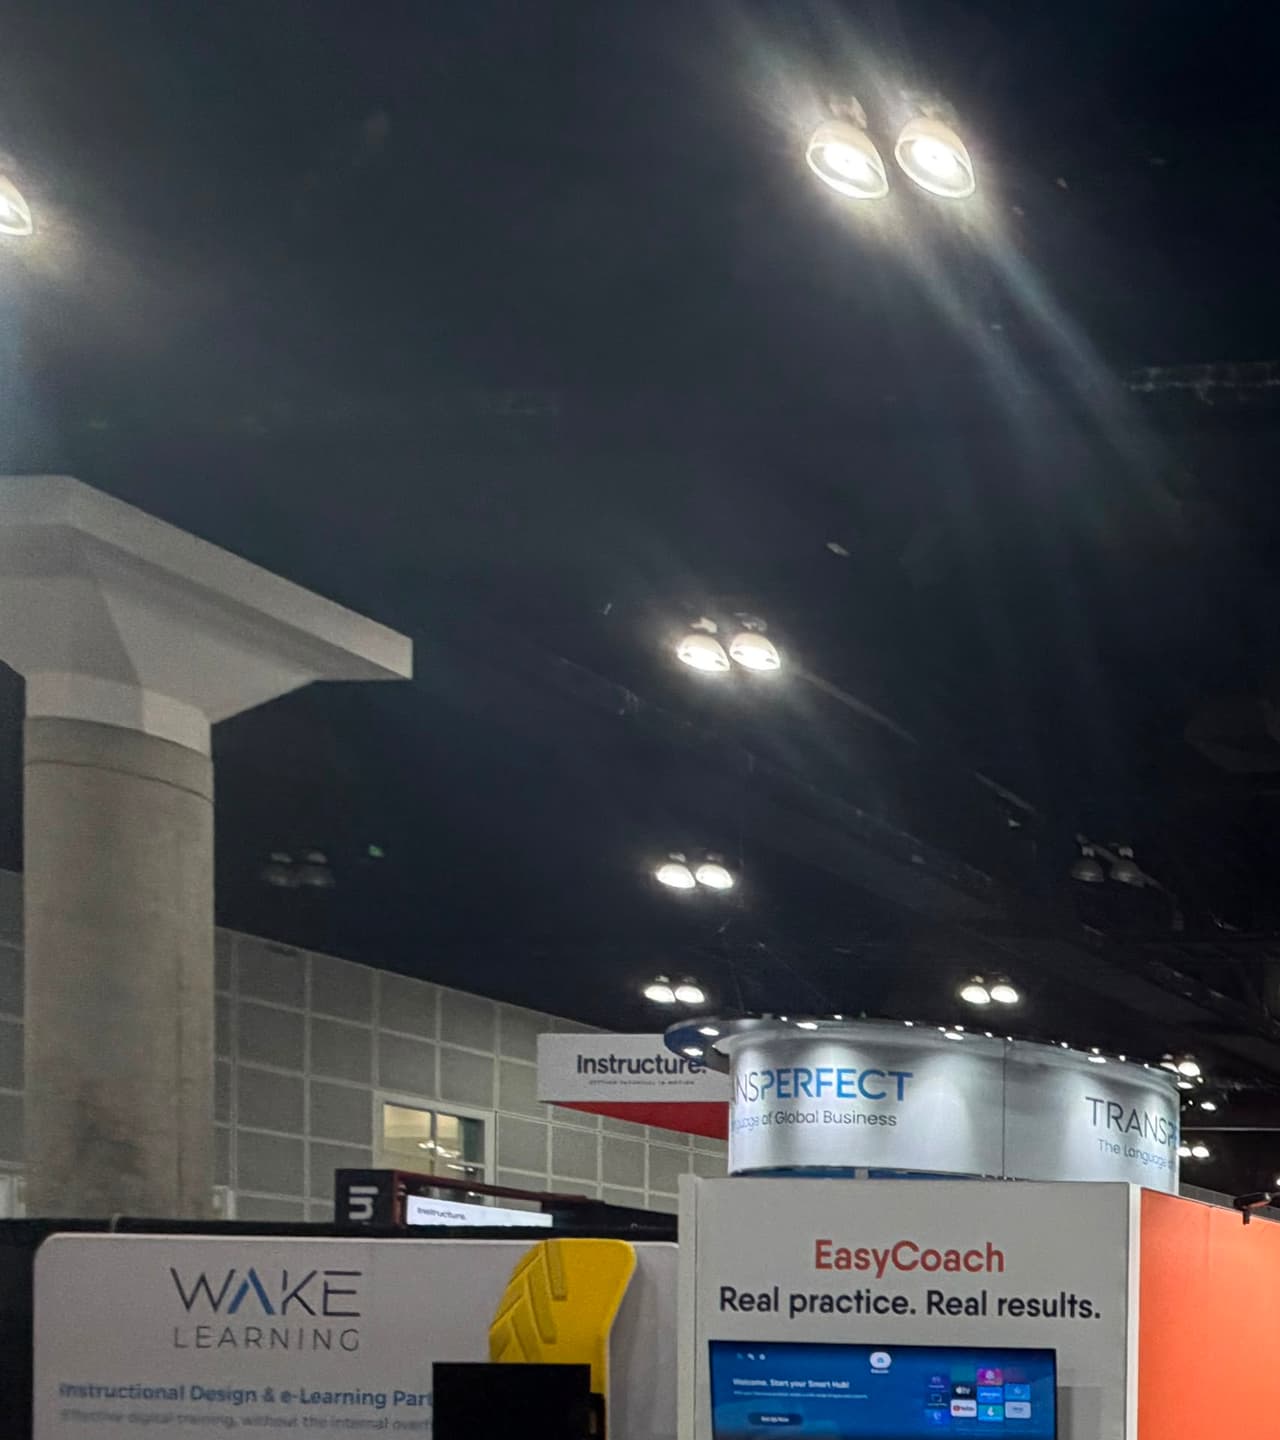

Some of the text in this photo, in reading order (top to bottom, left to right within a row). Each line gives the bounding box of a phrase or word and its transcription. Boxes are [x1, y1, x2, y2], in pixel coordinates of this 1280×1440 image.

[577, 1053, 706, 1075] Instructure.
[761, 1112, 773, 1125] of
[774, 1111, 819, 1125] Global
[823, 1111, 898, 1127] Business
[1098, 1138, 1121, 1154] The
[815, 1239, 1005, 1279] EasyCoach
[170, 1267, 362, 1317] WAKE
[720, 1285, 1101, 1320] Real practice. Real results.
[174, 1325, 360, 1352] LEARNING
[60, 1383, 185, 1400] Instructional
[191, 1386, 257, 1406] Design
[280, 1388, 387, 1409] e-Learning
